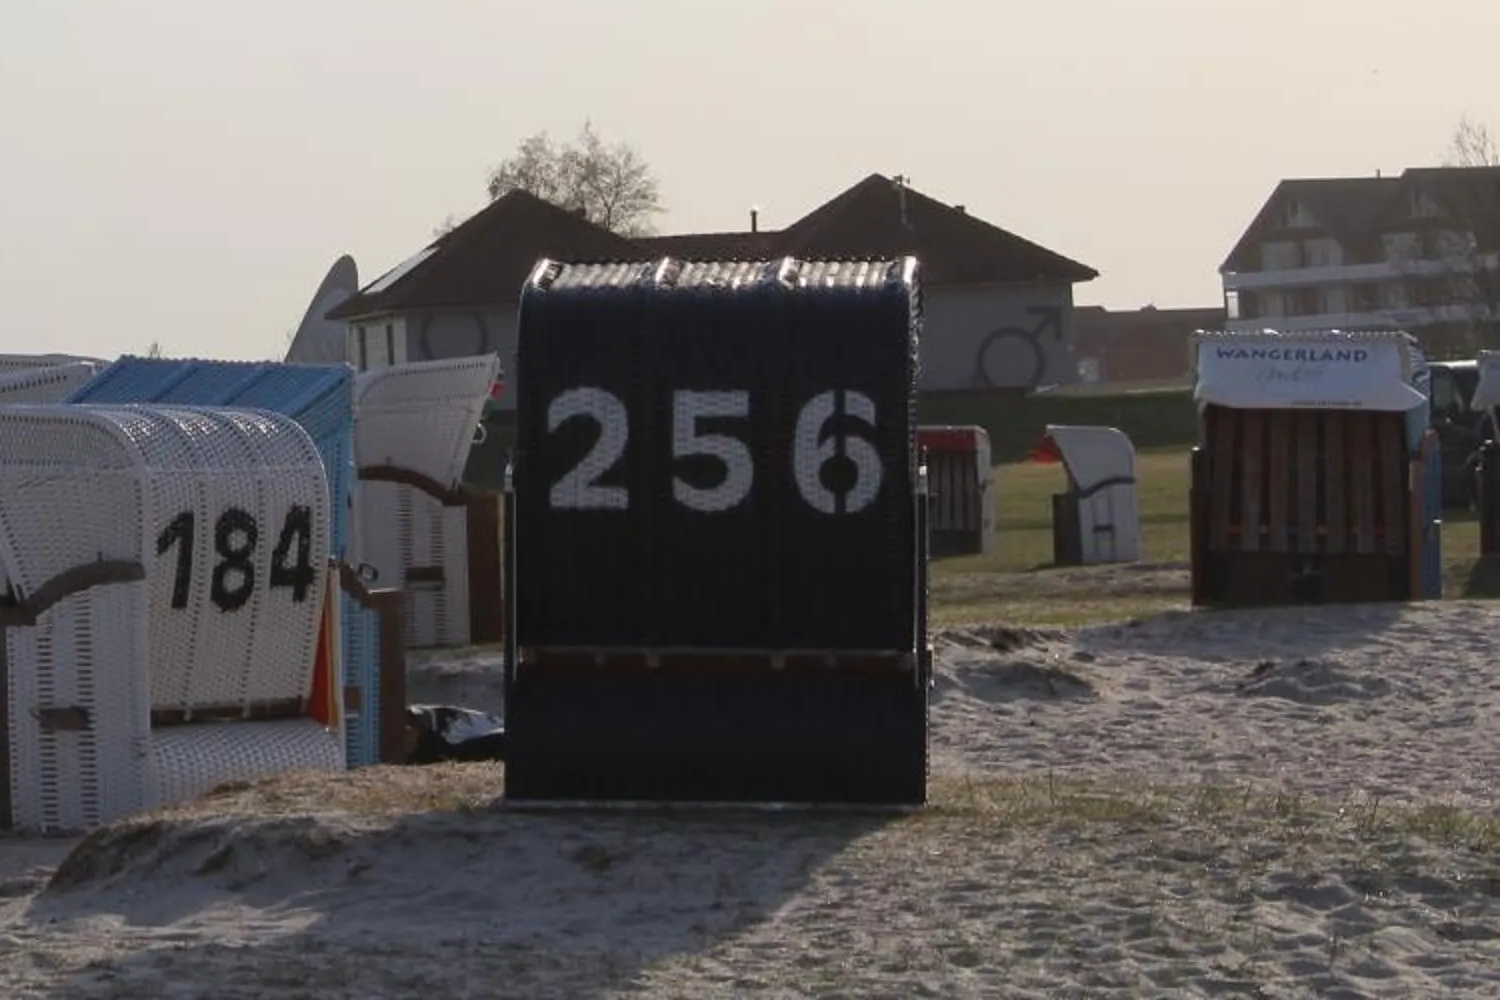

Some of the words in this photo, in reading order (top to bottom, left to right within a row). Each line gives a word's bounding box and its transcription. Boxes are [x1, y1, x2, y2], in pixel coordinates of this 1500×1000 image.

[1217, 348, 1368, 362] WANGERLAND
[546, 387, 884, 514] 256
[156, 505, 316, 612] 184
